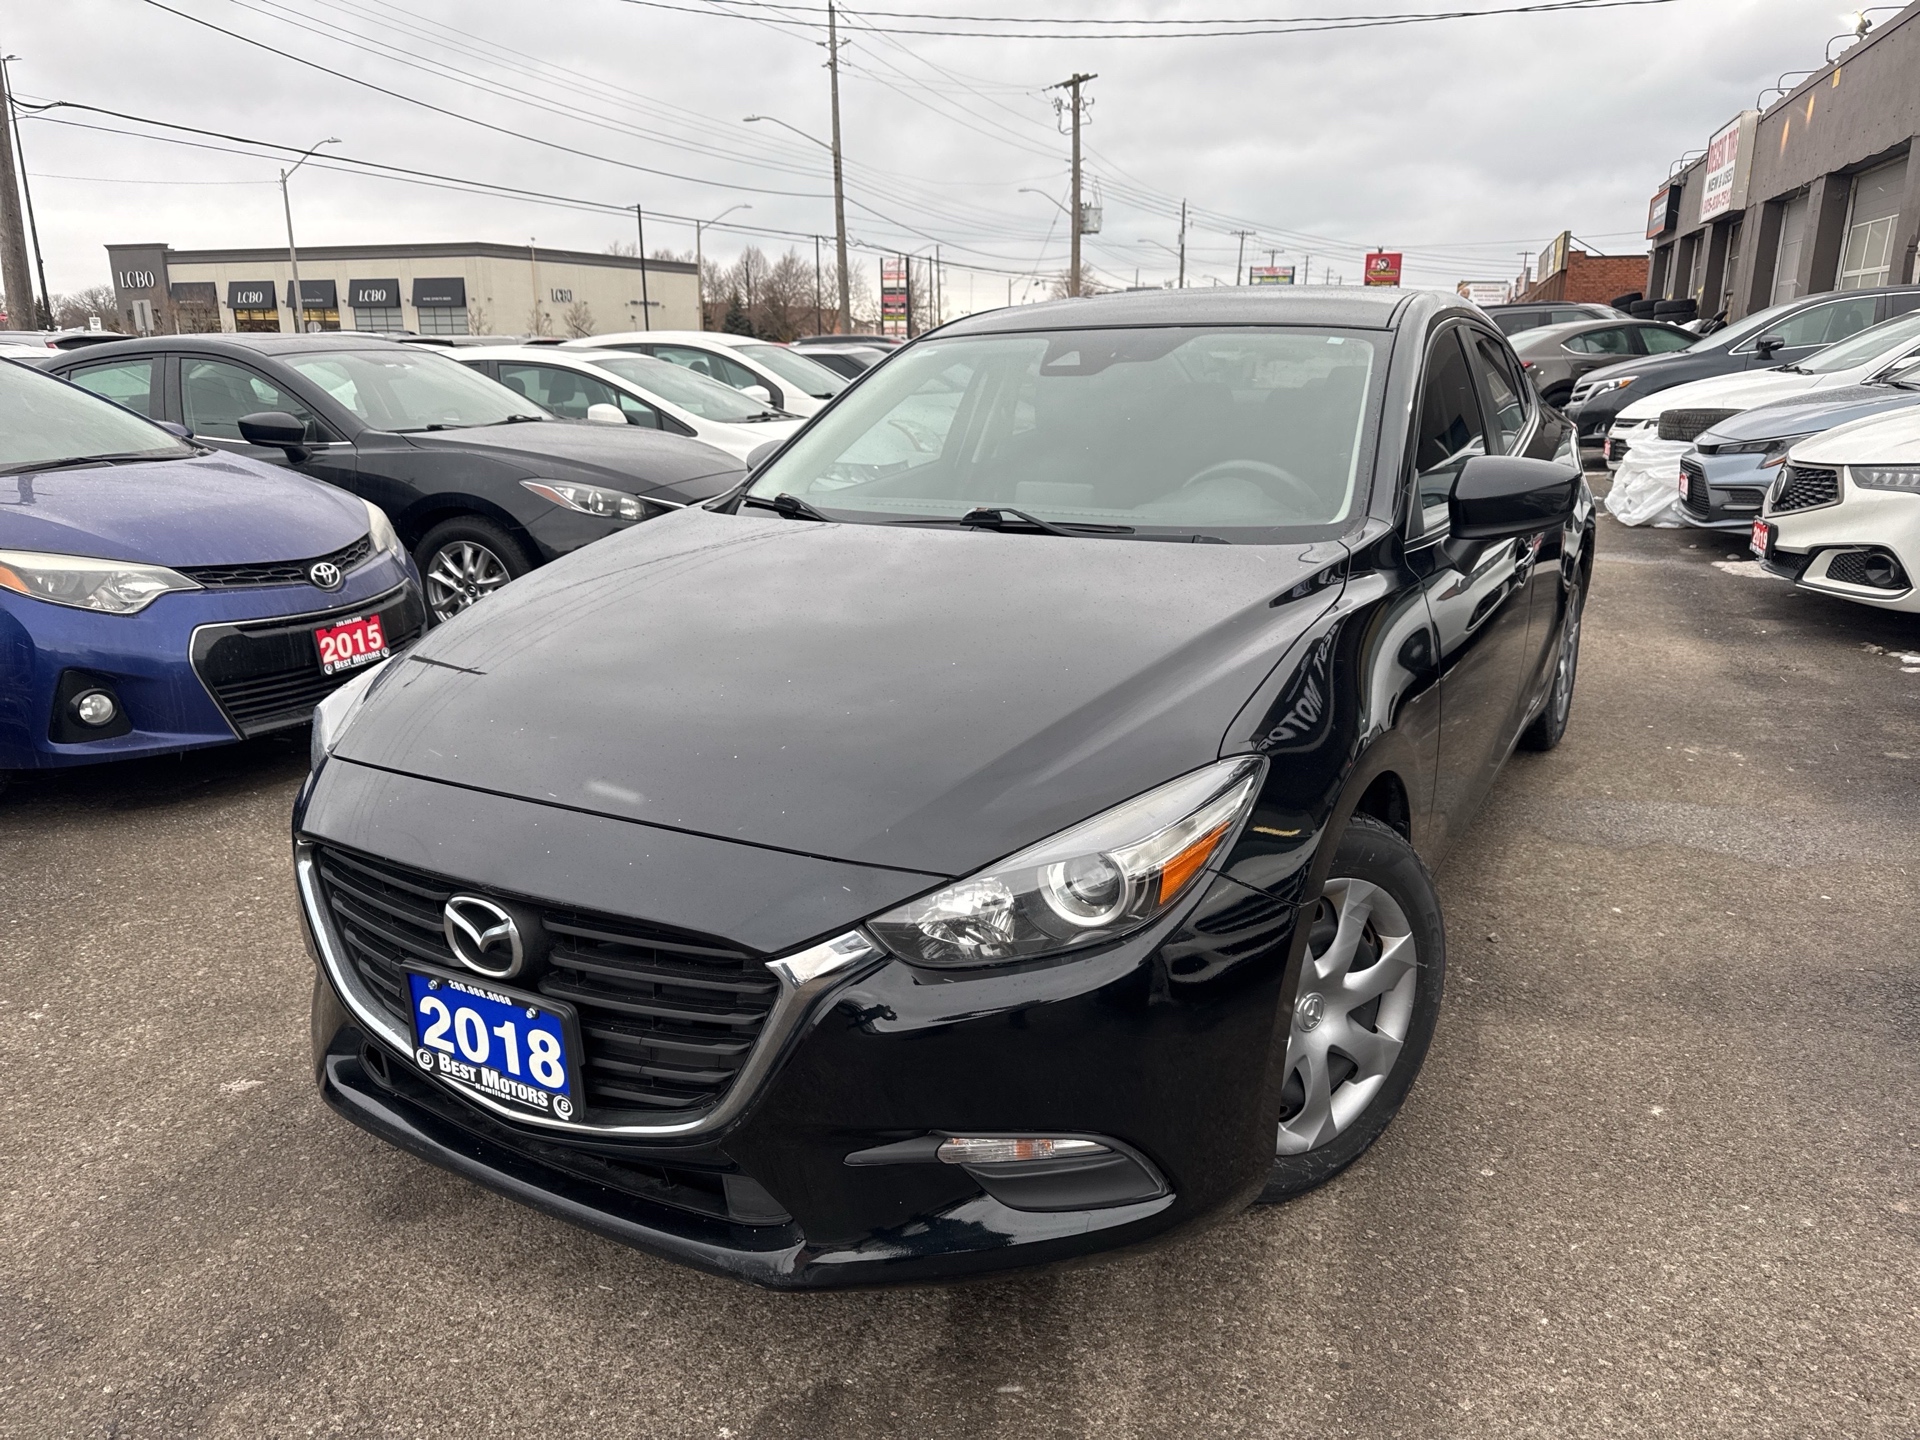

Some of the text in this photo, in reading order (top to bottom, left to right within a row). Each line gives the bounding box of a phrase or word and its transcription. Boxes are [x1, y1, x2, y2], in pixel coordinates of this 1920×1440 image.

[119, 270, 155, 288] LCBO
[237, 290, 263, 304] LCBO
[358, 288, 386, 302] LCBO
[550, 288, 572, 303] LCBO
[1752, 525, 1768, 550] 2019
[320, 624, 382, 664] 2015
[334, 659, 351, 669] BEST
[352, 650, 381, 664] MOTORS
[419, 996, 565, 1088] 2018
[438, 1052, 476, 1081] BEST
[481, 1066, 548, 1107] MOTORS
